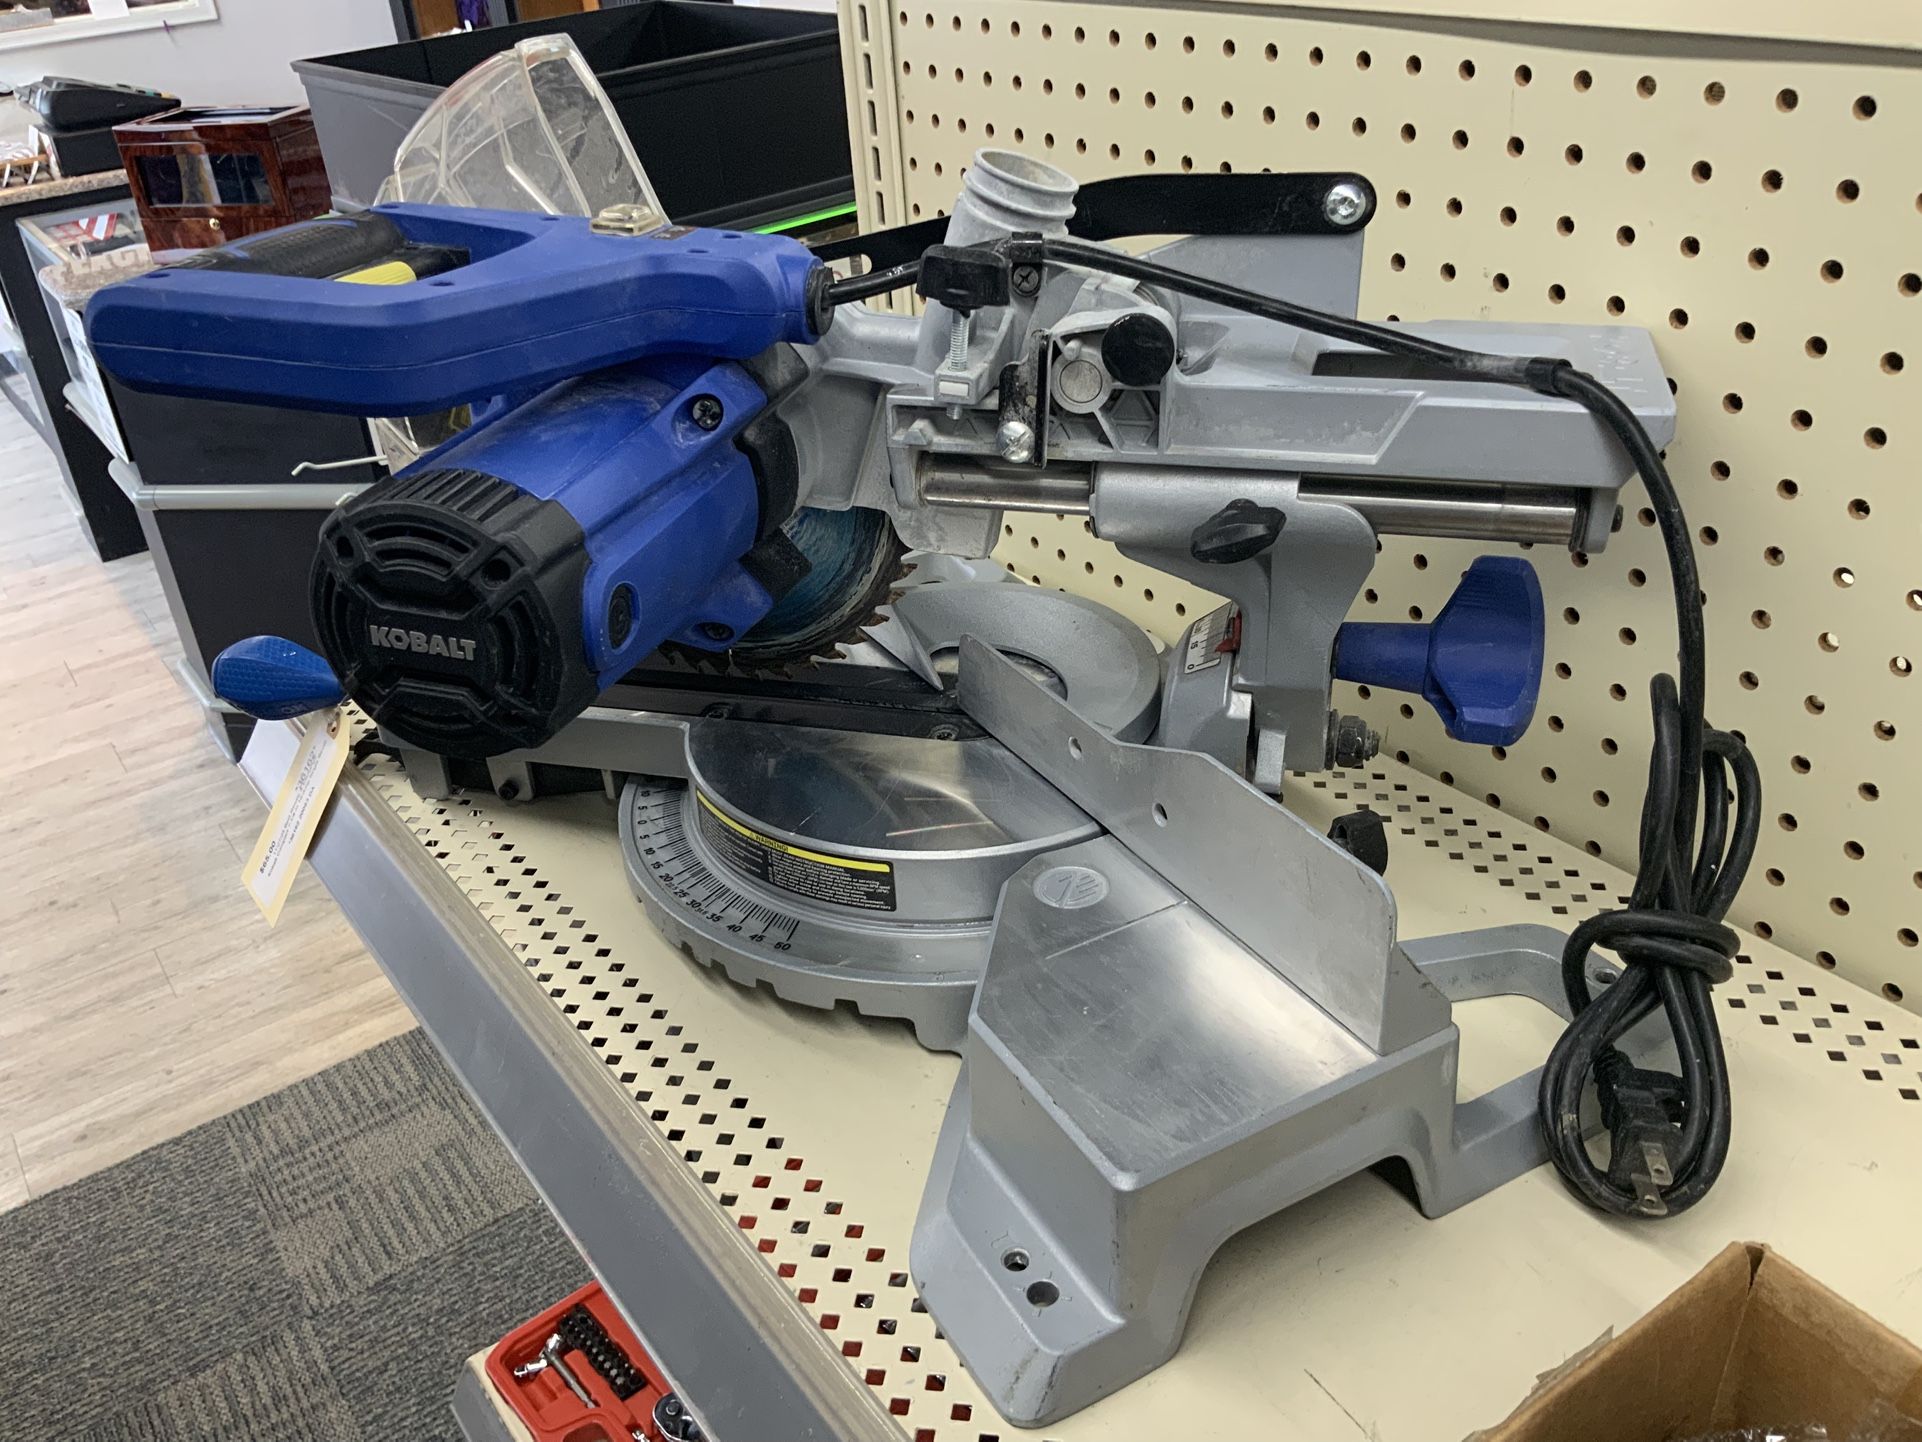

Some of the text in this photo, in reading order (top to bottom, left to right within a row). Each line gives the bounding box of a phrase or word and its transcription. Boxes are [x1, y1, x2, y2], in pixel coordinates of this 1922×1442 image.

[369, 625, 477, 661] KOBALT
[1190, 640, 1199, 650] 15
[1187, 663, 1195, 671] 0
[640, 789, 651, 798] 10
[755, 835, 789, 853] WARNING!
[643, 847, 656, 856] 10
[260, 840, 276, 874] $65.00
[650, 861, 665, 870] 15
[659, 873, 674, 883] 20
[673, 890, 690, 899] 25
[686, 898, 702, 909] 30
[706, 913, 724, 923] 35
[726, 924, 743, 933] 40
[749, 934, 766, 943] 45
